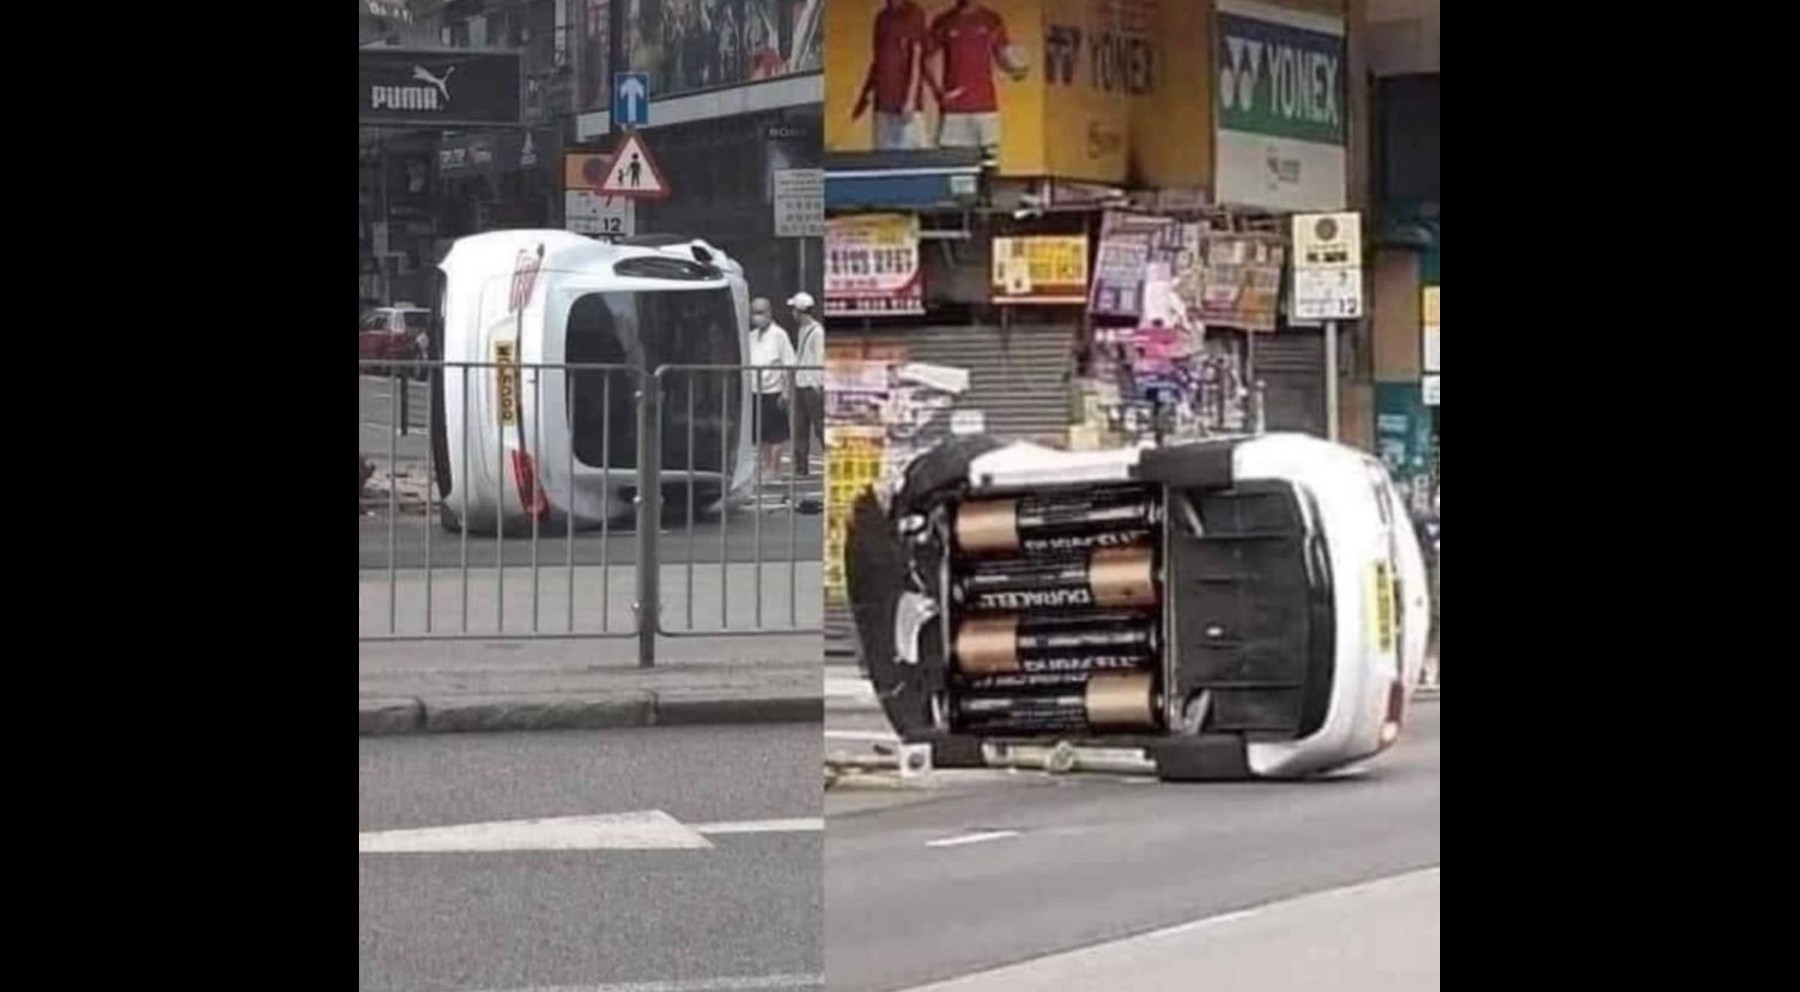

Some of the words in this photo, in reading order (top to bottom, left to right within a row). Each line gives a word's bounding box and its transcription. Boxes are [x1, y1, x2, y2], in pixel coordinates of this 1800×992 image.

[1266, 43, 1339, 128] YONEX
[371, 86, 438, 110] PUMA
[603, 217, 621, 232] 12
[980, 589, 1091, 608] DURACELL
